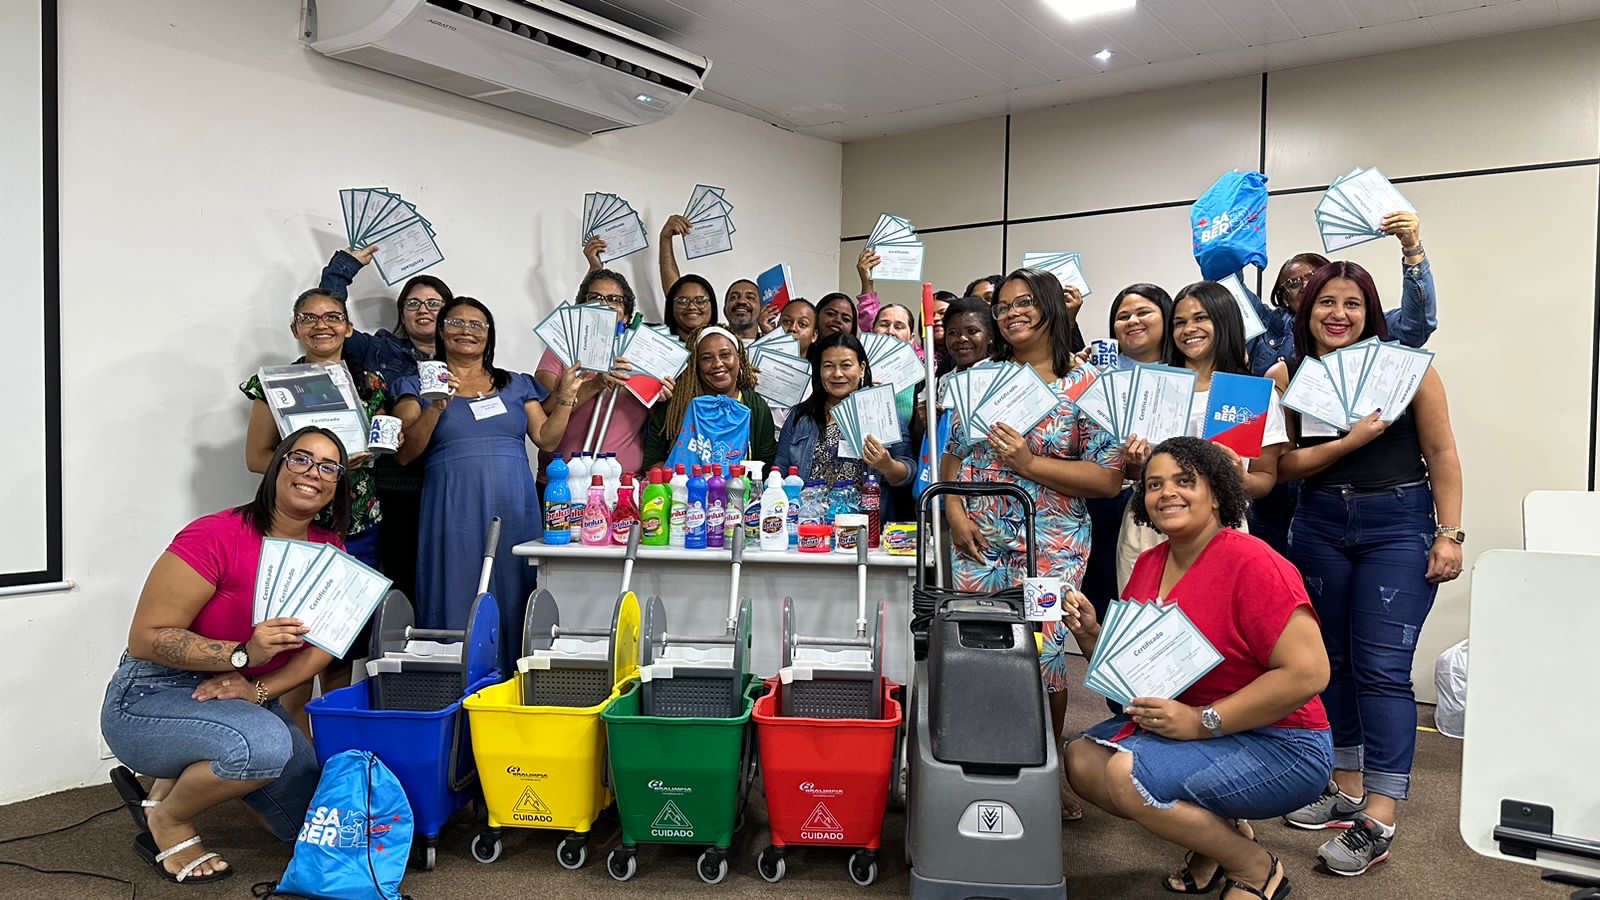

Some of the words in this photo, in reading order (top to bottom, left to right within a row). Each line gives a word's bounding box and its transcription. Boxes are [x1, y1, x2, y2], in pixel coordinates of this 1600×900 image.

[1212, 210, 1230, 225] SA
[1098, 342, 1118, 354] SA
[1091, 354, 1118, 367] BER
[993, 383, 1019, 406] Certificado
[1138, 390, 1149, 421] Certificado
[1222, 405, 1237, 414] SA
[1214, 411, 1236, 423] BER
[262, 564, 274, 601] Certificado
[279, 567, 296, 603] Certificado
[309, 578, 335, 610] Certificado
[1132, 631, 1165, 657] Certificado
[312, 806, 341, 828] SA
[512, 813, 553, 823] CUIDADO
[651, 829, 694, 838] CUIDADO
[800, 831, 844, 840] CUIDADO
